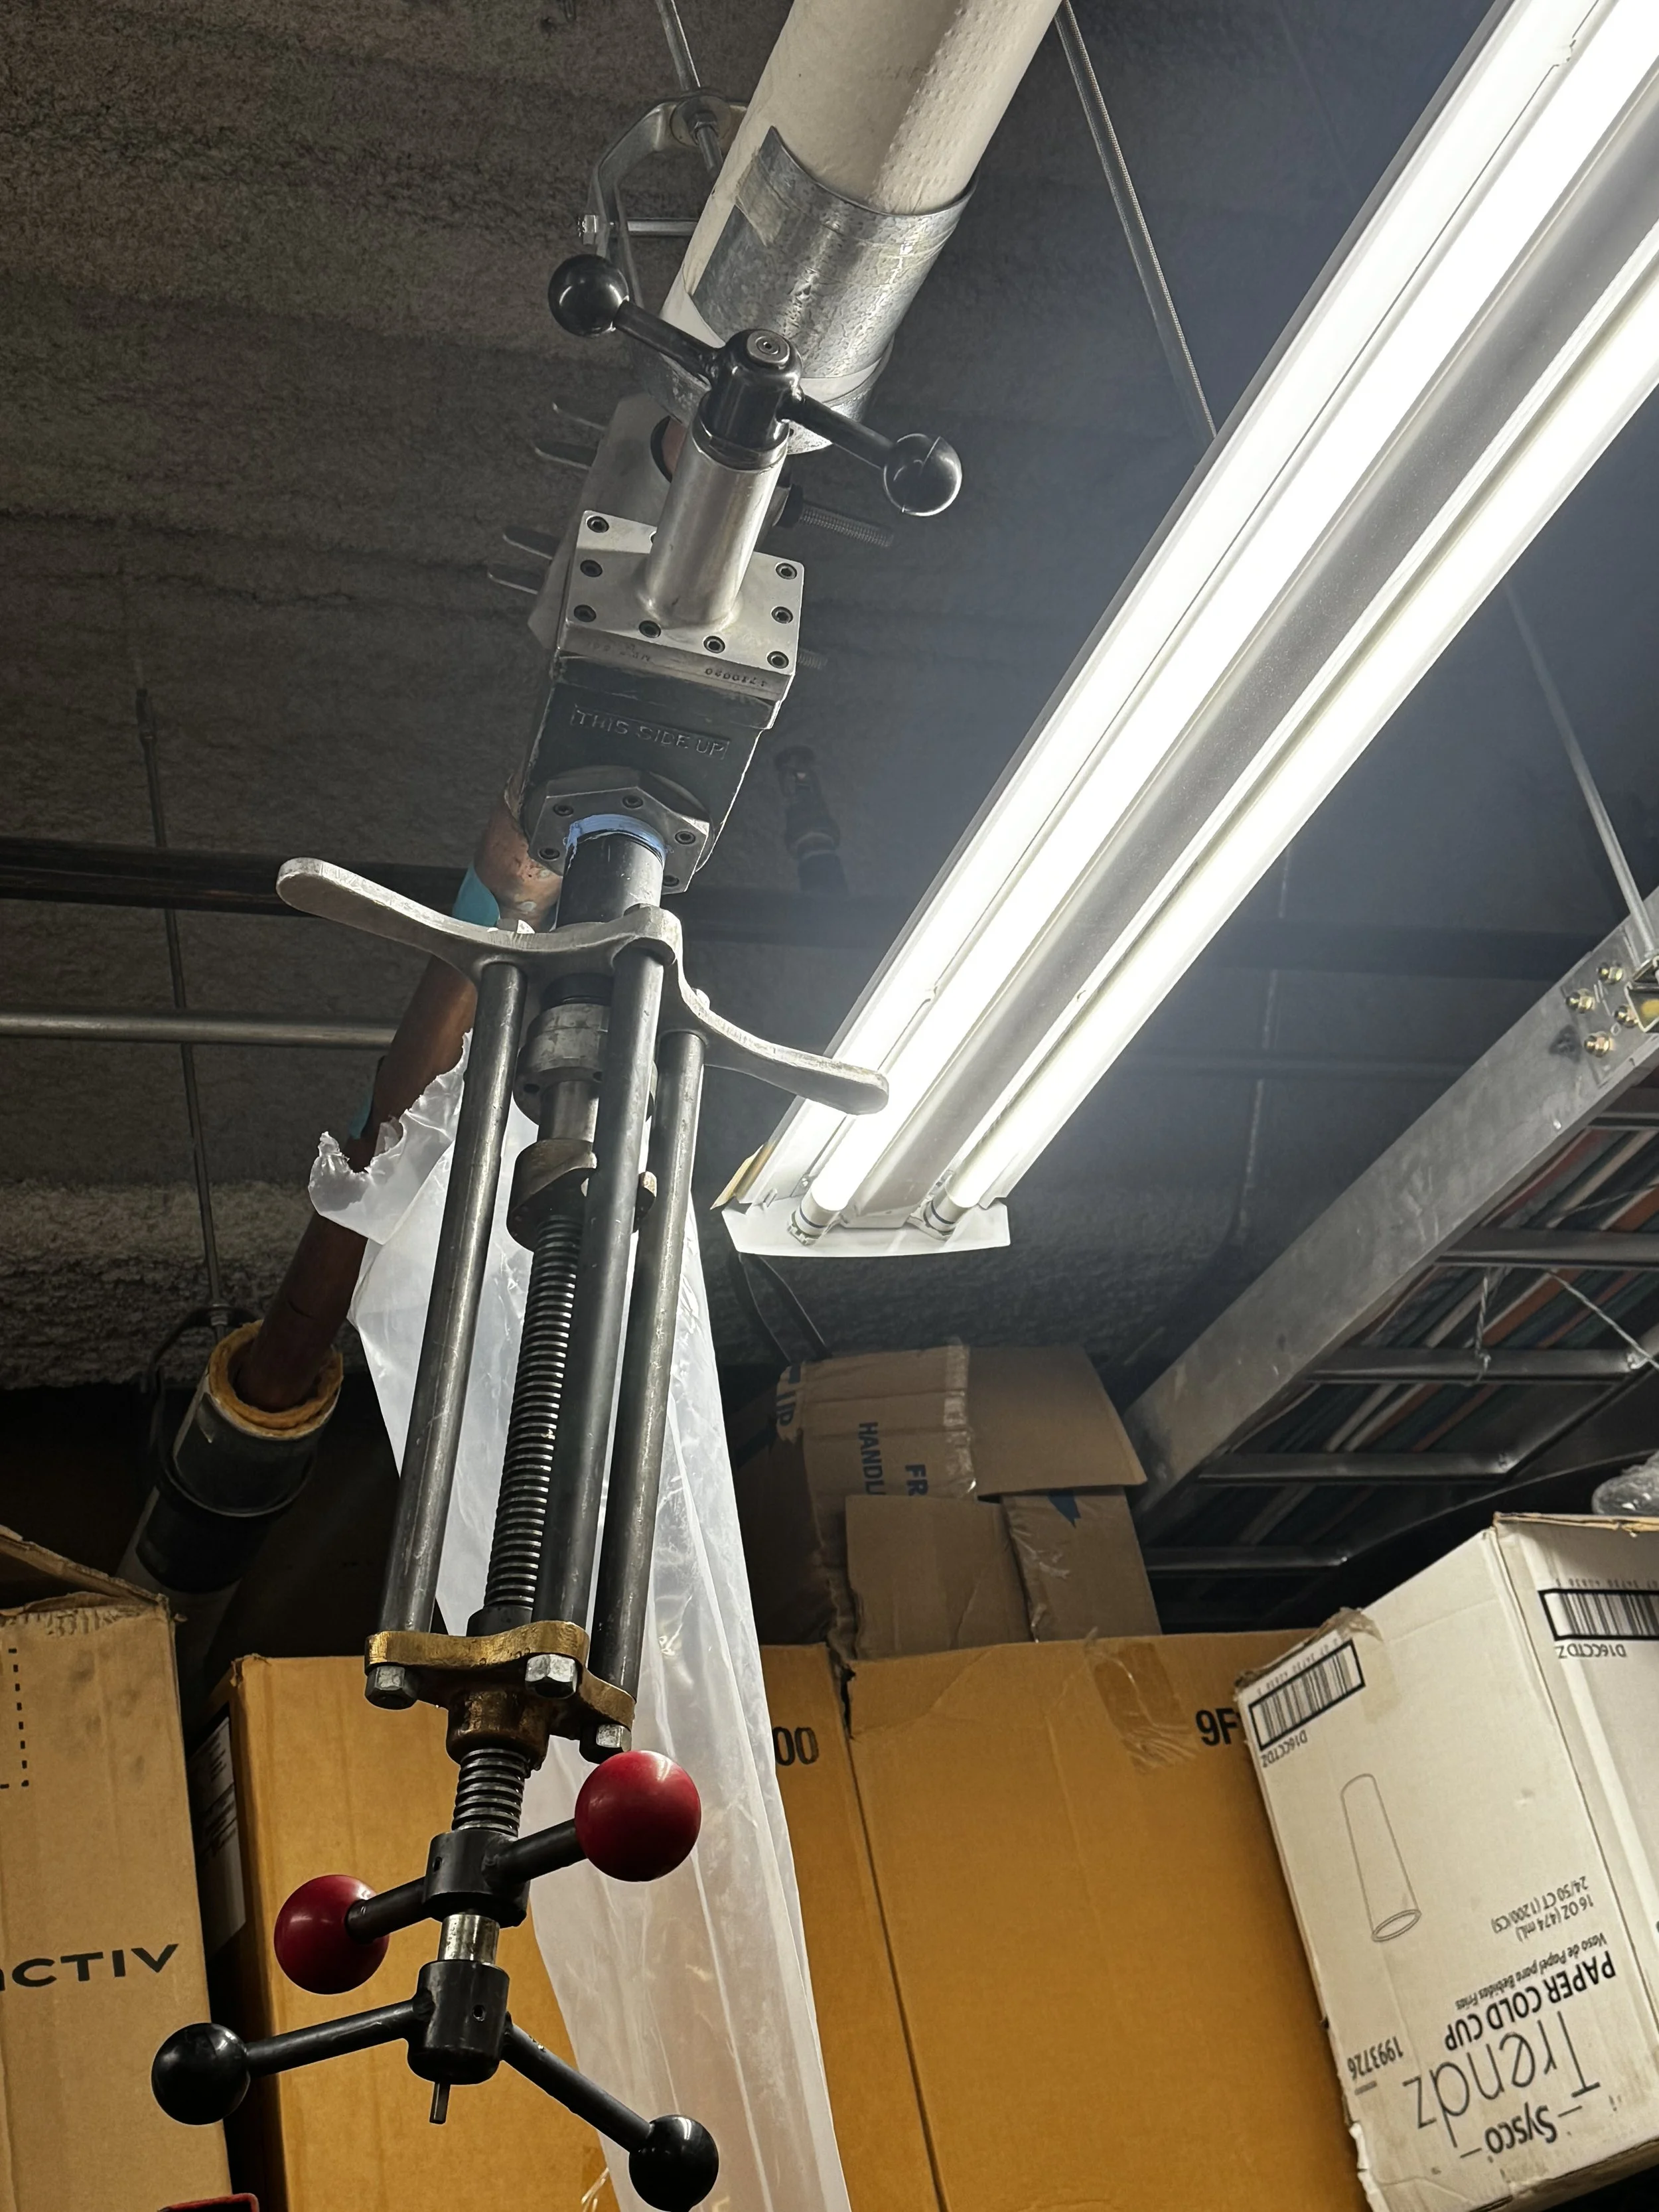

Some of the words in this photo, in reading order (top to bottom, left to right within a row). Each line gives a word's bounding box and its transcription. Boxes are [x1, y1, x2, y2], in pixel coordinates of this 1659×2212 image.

[576, 709, 629, 735] THIS
[636, 725, 691, 749] SIDE
[696, 739, 726, 756] UP
[1542, 1892, 1557, 1910] CT
[1556, 1876, 1589, 1902] 24/50
[1579, 1894, 1594, 1907] 16
[1537, 1907, 1561, 1931] (474
[1561, 1901, 1579, 1920] OZ
[1567, 1944, 1580, 1958] de
[1581, 1933, 1607, 1951] Vaso
[0, 1943, 179, 1991] CTIV
[1543, 1951, 1617, 2004] PAPER
[1486, 1986, 1542, 2031] COLD
[1445, 2013, 1484, 2051] CUP
[1347, 2036, 1403, 2079] 1993726
[1403, 2012, 1600, 2148] Trendz
[1485, 2102, 1557, 2154] Sysco
